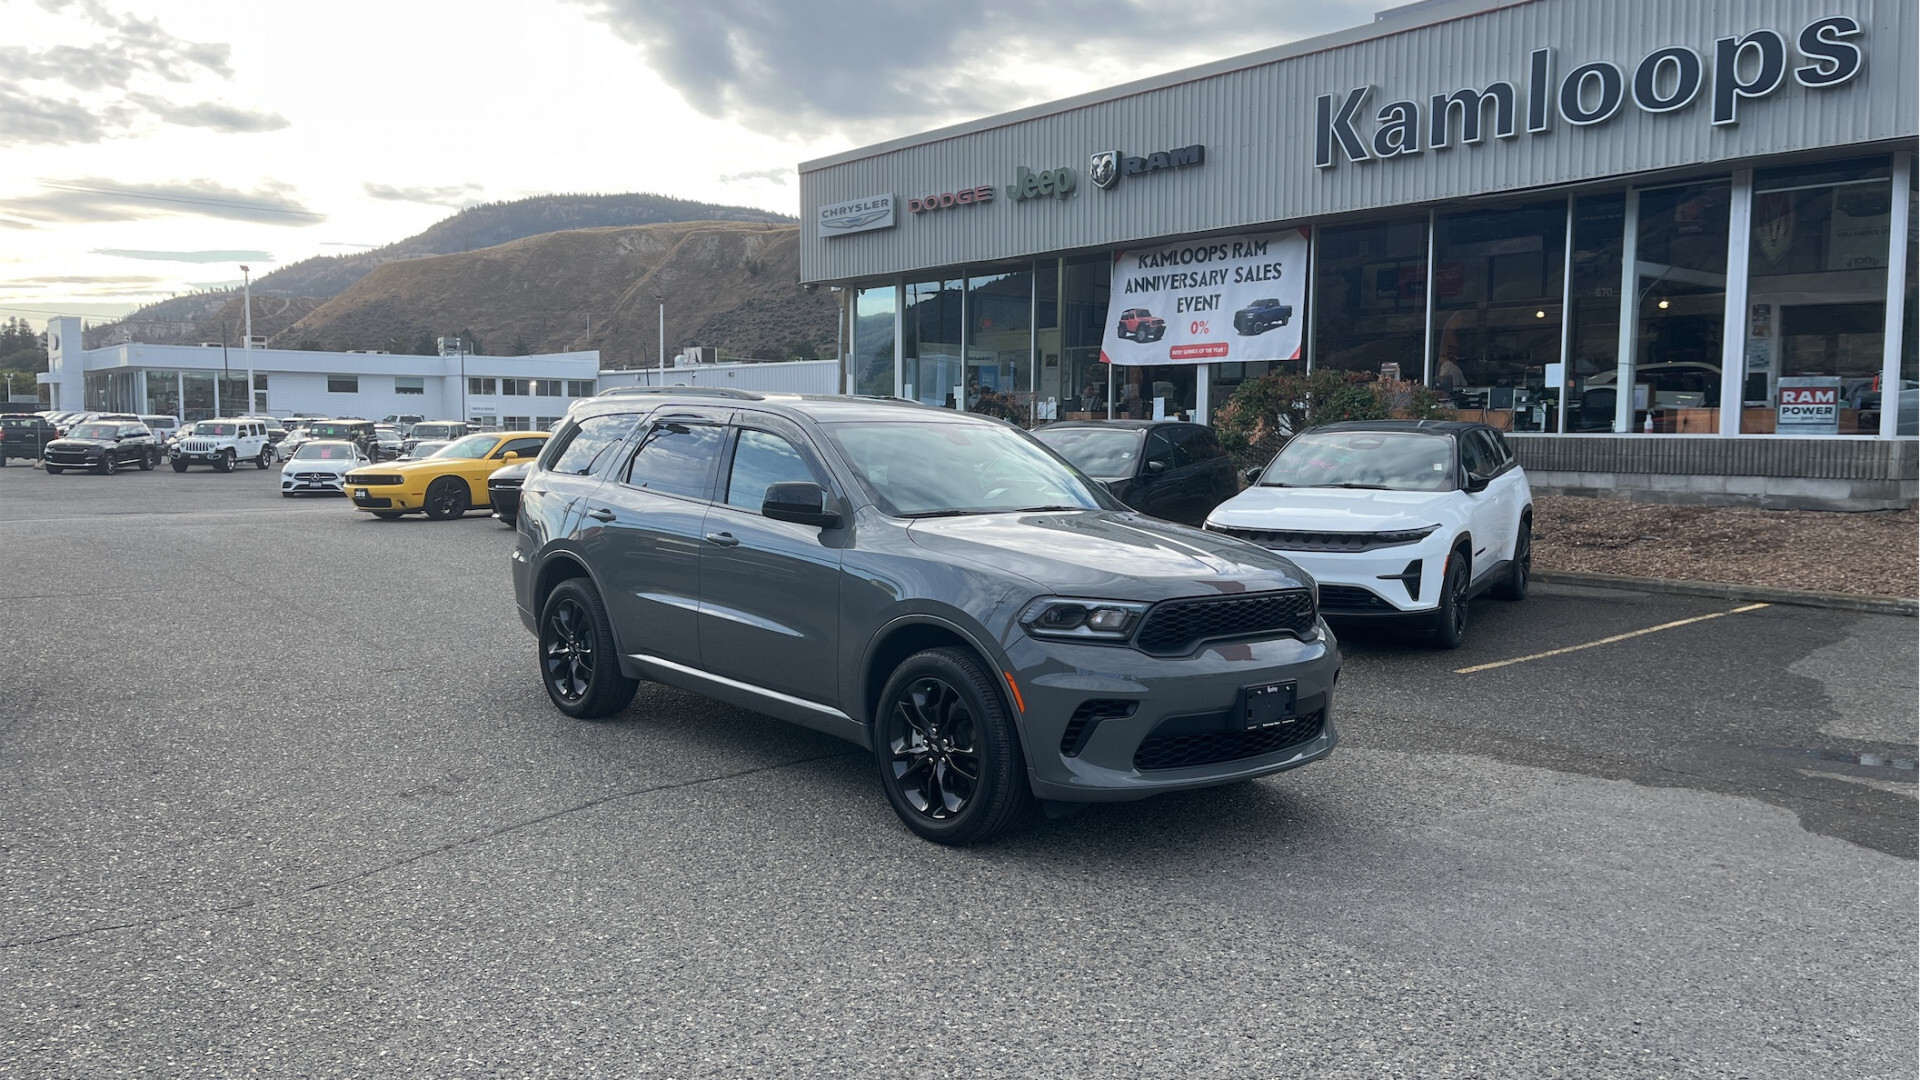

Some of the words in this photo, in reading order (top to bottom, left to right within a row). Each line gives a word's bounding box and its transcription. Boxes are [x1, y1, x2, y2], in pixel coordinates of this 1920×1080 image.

[1314, 15, 1866, 171] Kamloops
[1122, 144, 1206, 176] RAM
[1006, 165, 1077, 201] Jeep
[821, 198, 889, 219] CHRYSLER
[908, 185, 994, 214] DODGE
[1138, 243, 1228, 270] KAMLOOPS
[1231, 239, 1270, 260] RAM
[1124, 268, 1229, 295] ANNIVERSARY
[1233, 262, 1283, 284] SALES
[1176, 293, 1222, 314] EVENT
[1190, 320, 1210, 335] 0%
[1782, 390, 1835, 403] RAM
[1782, 406, 1833, 415] POWER
